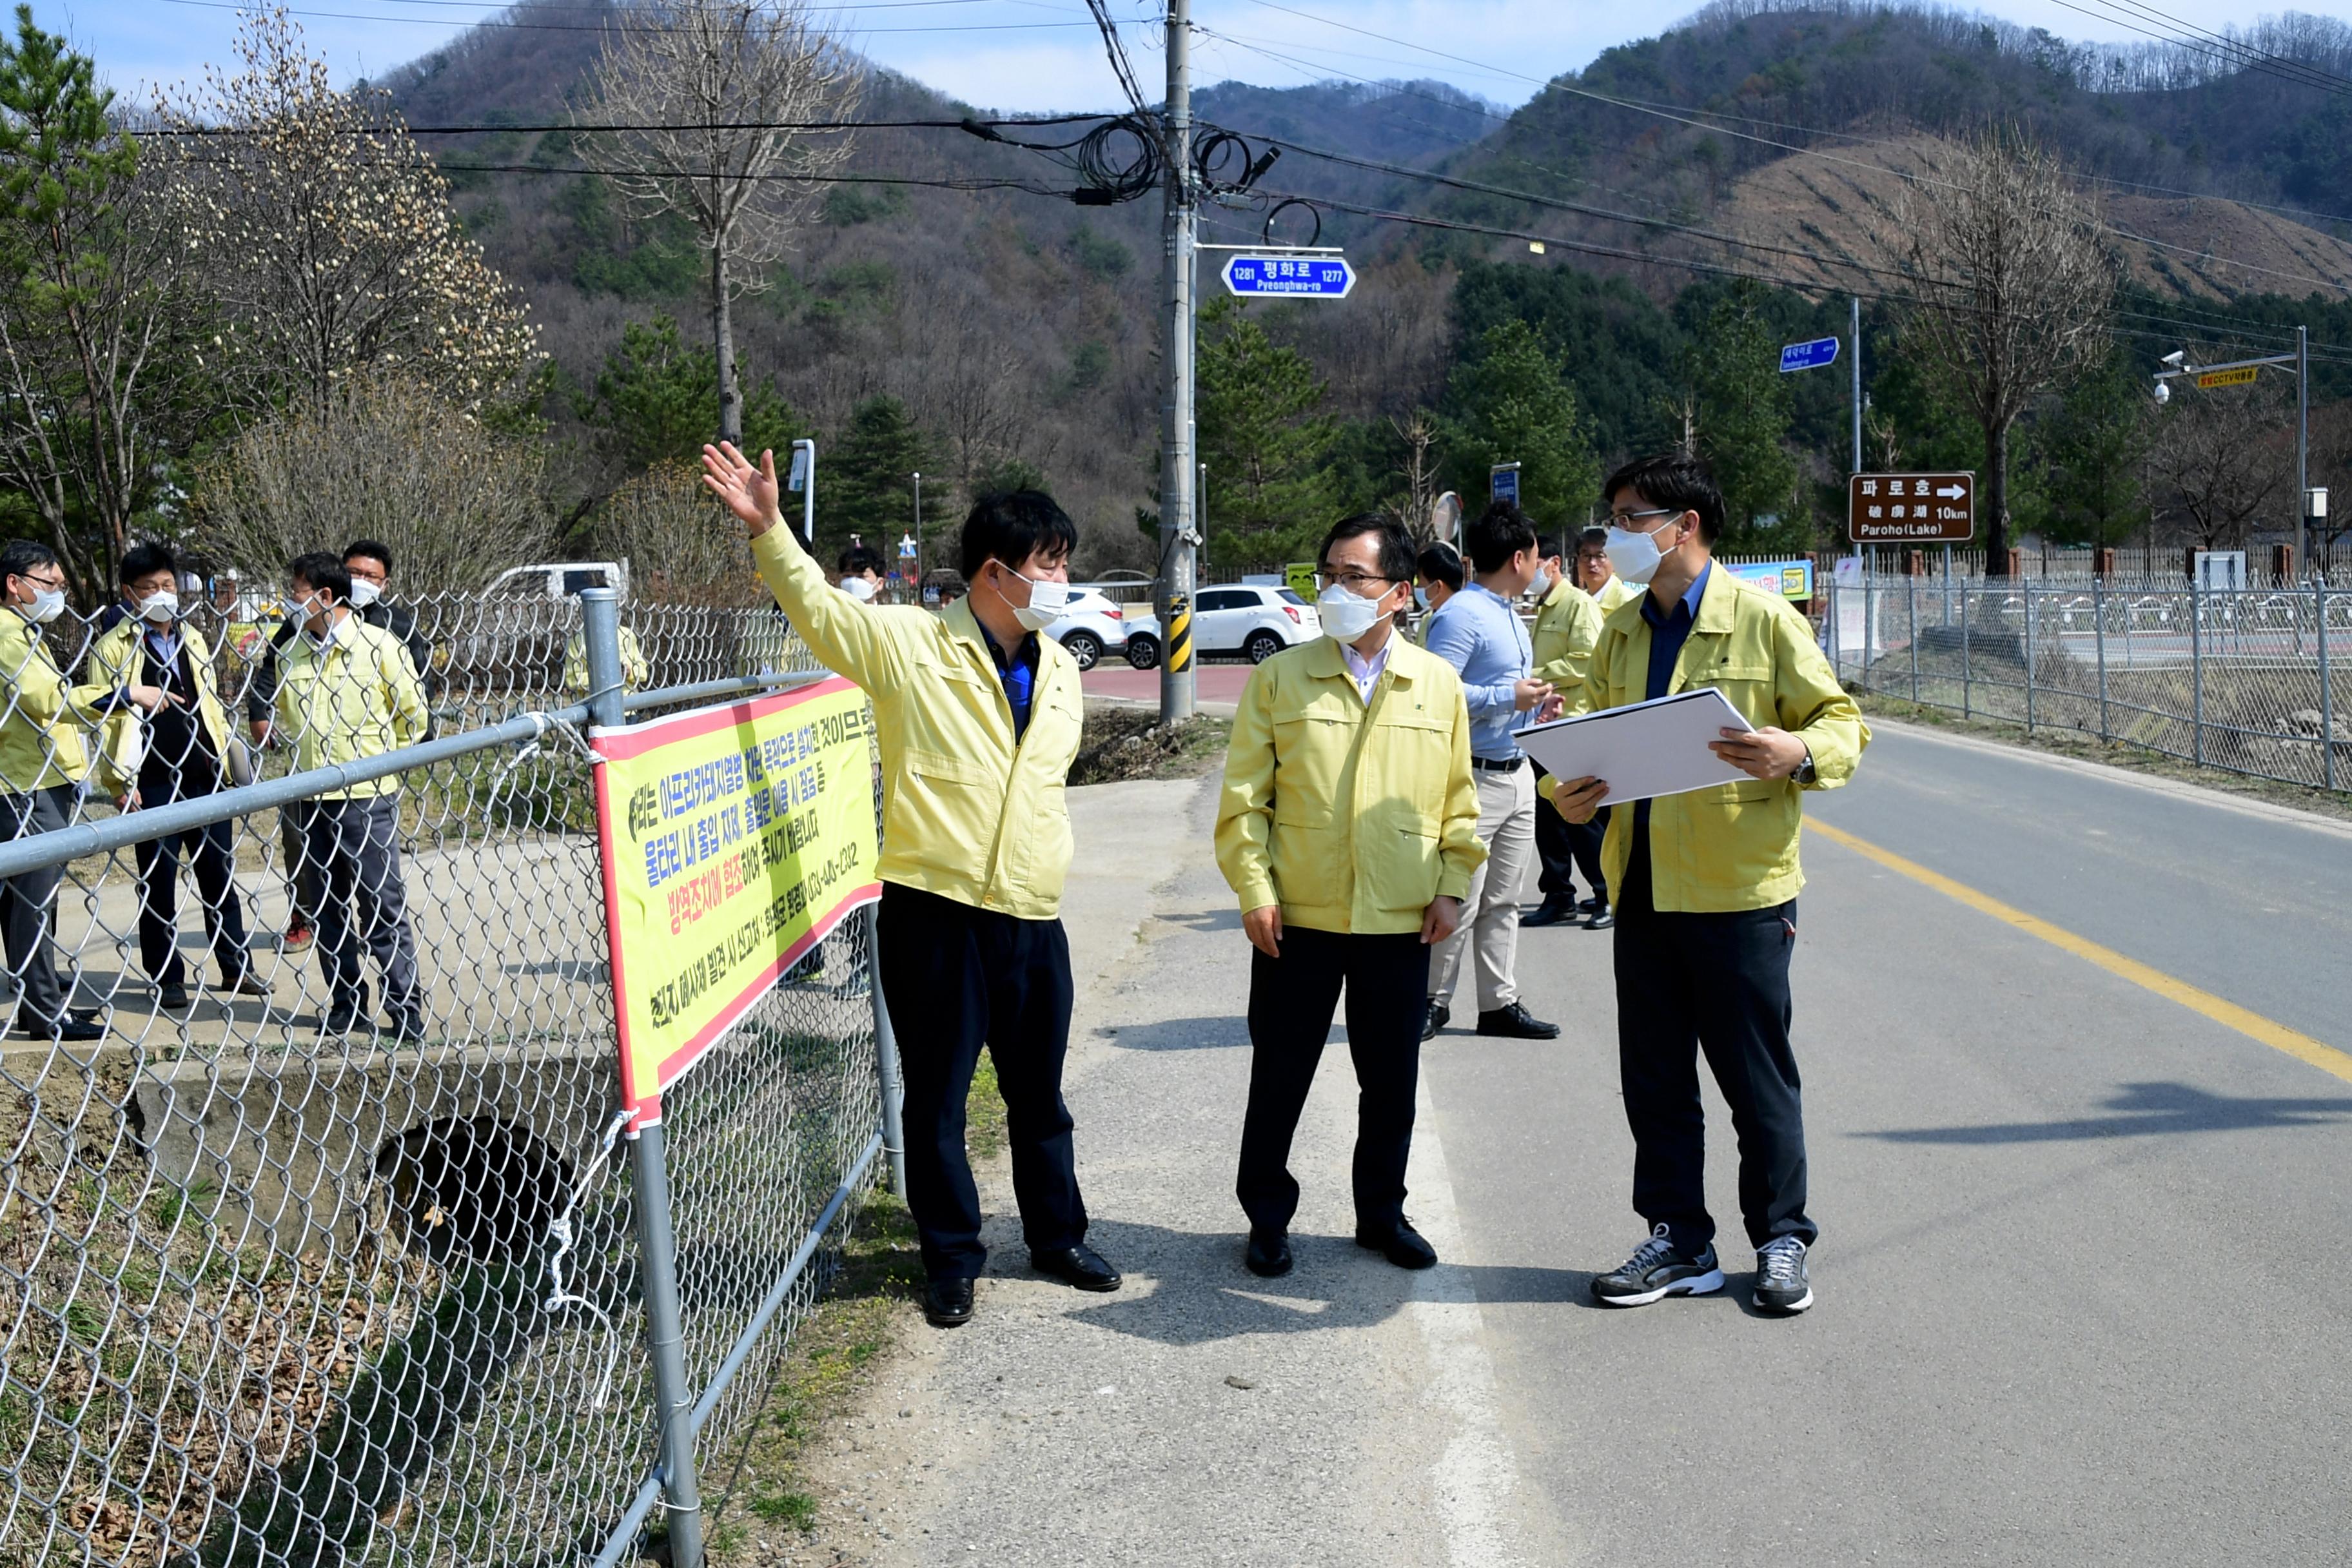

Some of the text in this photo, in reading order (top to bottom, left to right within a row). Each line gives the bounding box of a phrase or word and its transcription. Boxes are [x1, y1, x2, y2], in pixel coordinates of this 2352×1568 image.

[1234, 262, 1342, 282] 1281 평화로 1277
[1257, 279, 1321, 292] Pyeonghwa-ro
[1861, 523, 1942, 535] Paroho(Lake)
[1936, 507, 1967, 519] 10km
[660, 751, 743, 820] 아프리카돼지열병
[745, 744, 763, 783] 차단
[763, 731, 796, 775] 목적으로
[797, 720, 821, 761] 설치한
[645, 830, 682, 888] 울타리
[683, 824, 696, 867] 내
[697, 813, 720, 861] 출입
[745, 787, 772, 835] 출입문
[773, 779, 789, 818] 이용
[790, 774, 799, 807] 시
[799, 765, 816, 803] 잠금
[816, 760, 825, 794] 등
[667, 807, 819, 936] 방역조치에 협조하여 주시기 바랍니다
[707, 942, 726, 986] 발견
[728, 934, 736, 968] 시
[738, 915, 761, 961] 신고처
[765, 894, 787, 939] 화천군
